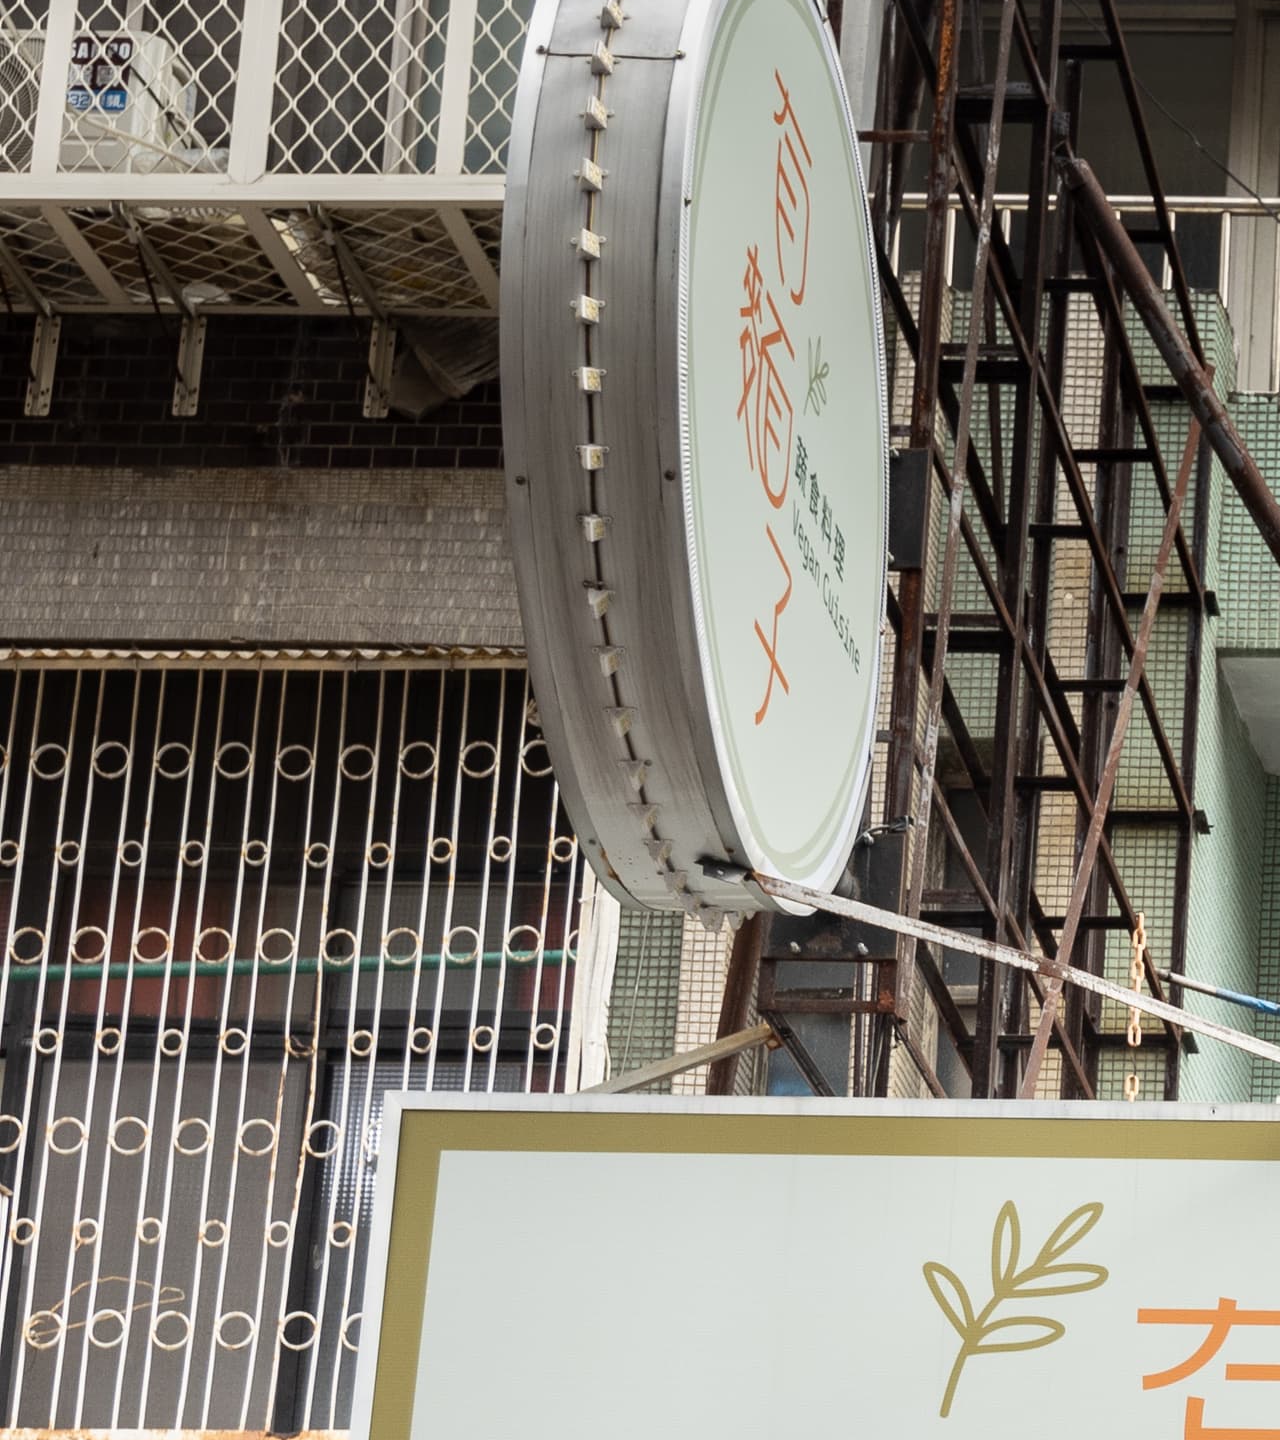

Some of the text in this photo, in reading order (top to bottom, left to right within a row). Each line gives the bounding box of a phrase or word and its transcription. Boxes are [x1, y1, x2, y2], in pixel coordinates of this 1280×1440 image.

[793, 498, 862, 674] Vegan Cuisine
[796, 434, 848, 584] 蔬食料理
